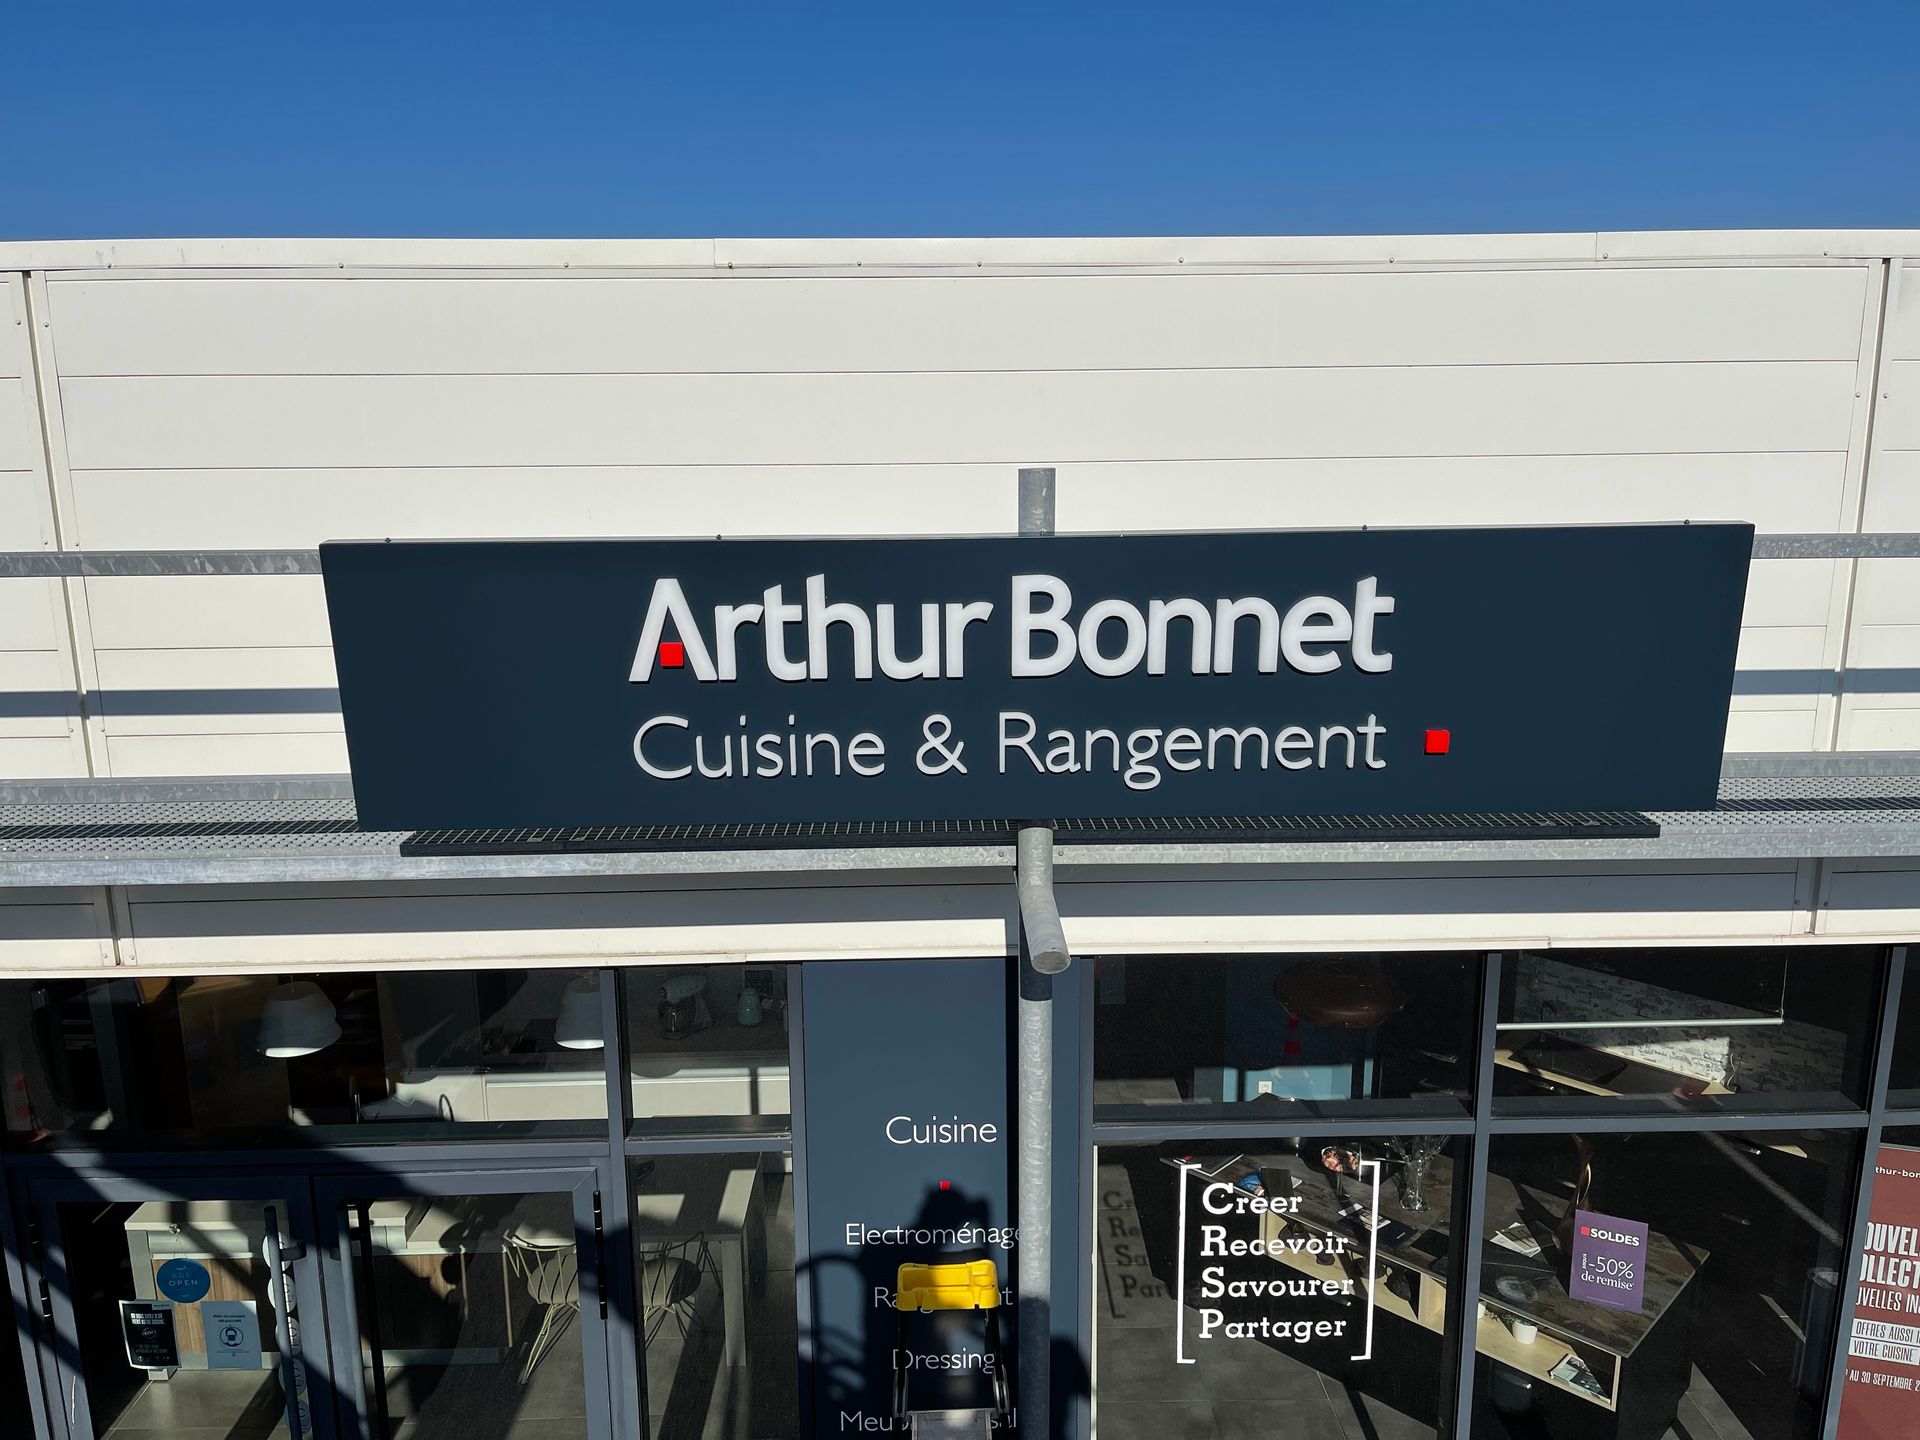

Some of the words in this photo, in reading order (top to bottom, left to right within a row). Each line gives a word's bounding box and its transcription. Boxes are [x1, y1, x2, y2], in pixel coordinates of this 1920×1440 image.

[628, 573, 993, 683] Arthur
[1011, 573, 1395, 678] Bonnet
[632, 713, 886, 780] Cuisine
[916, 712, 969, 776] &
[998, 711, 1387, 791] Rangement
[885, 1115, 997, 1144] Cuisine
[1202, 1182, 1302, 1215] Créer
[1200, 1225, 1349, 1256] Recevoir
[1590, 1228, 1640, 1246] SOLDES
[1864, 1221, 1920, 1257] OUVEL
[1581, 1271, 1595, 1283] de
[1588, 1256, 1634, 1279] -50%
[168, 1279, 199, 1287] OPEN
[1201, 1266, 1354, 1298] Savourer
[1906, 1293, 1920, 1314] IN
[1199, 1308, 1347, 1343] Partager
[1855, 1321, 1886, 1338] OFFRES
[1888, 1326, 1914, 1343] AUSSI
[892, 1347, 995, 1374] Dressing
[1854, 1340, 1880, 1356] VOTRE
[1849, 1369, 1860, 1382] AU
[1861, 1371, 1871, 1384] 30
[1872, 1373, 1913, 1390] SEPTEMBRE
